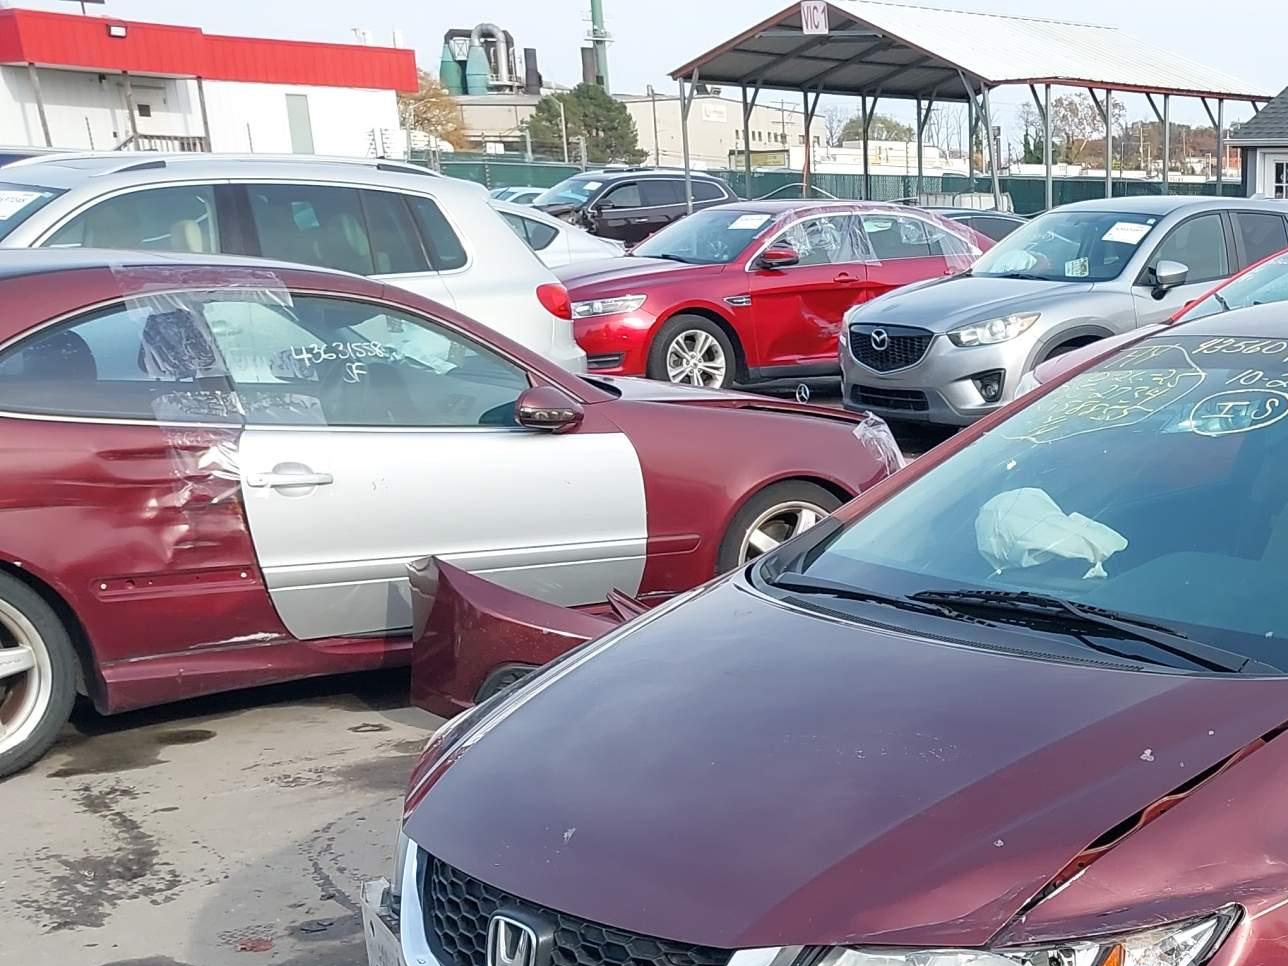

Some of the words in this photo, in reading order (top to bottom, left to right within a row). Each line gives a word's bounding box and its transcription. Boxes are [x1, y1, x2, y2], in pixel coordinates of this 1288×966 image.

[803, 5, 820, 30] VIC
[821, 5, 828, 30] 1
[290, 341, 385, 367] 43631558
